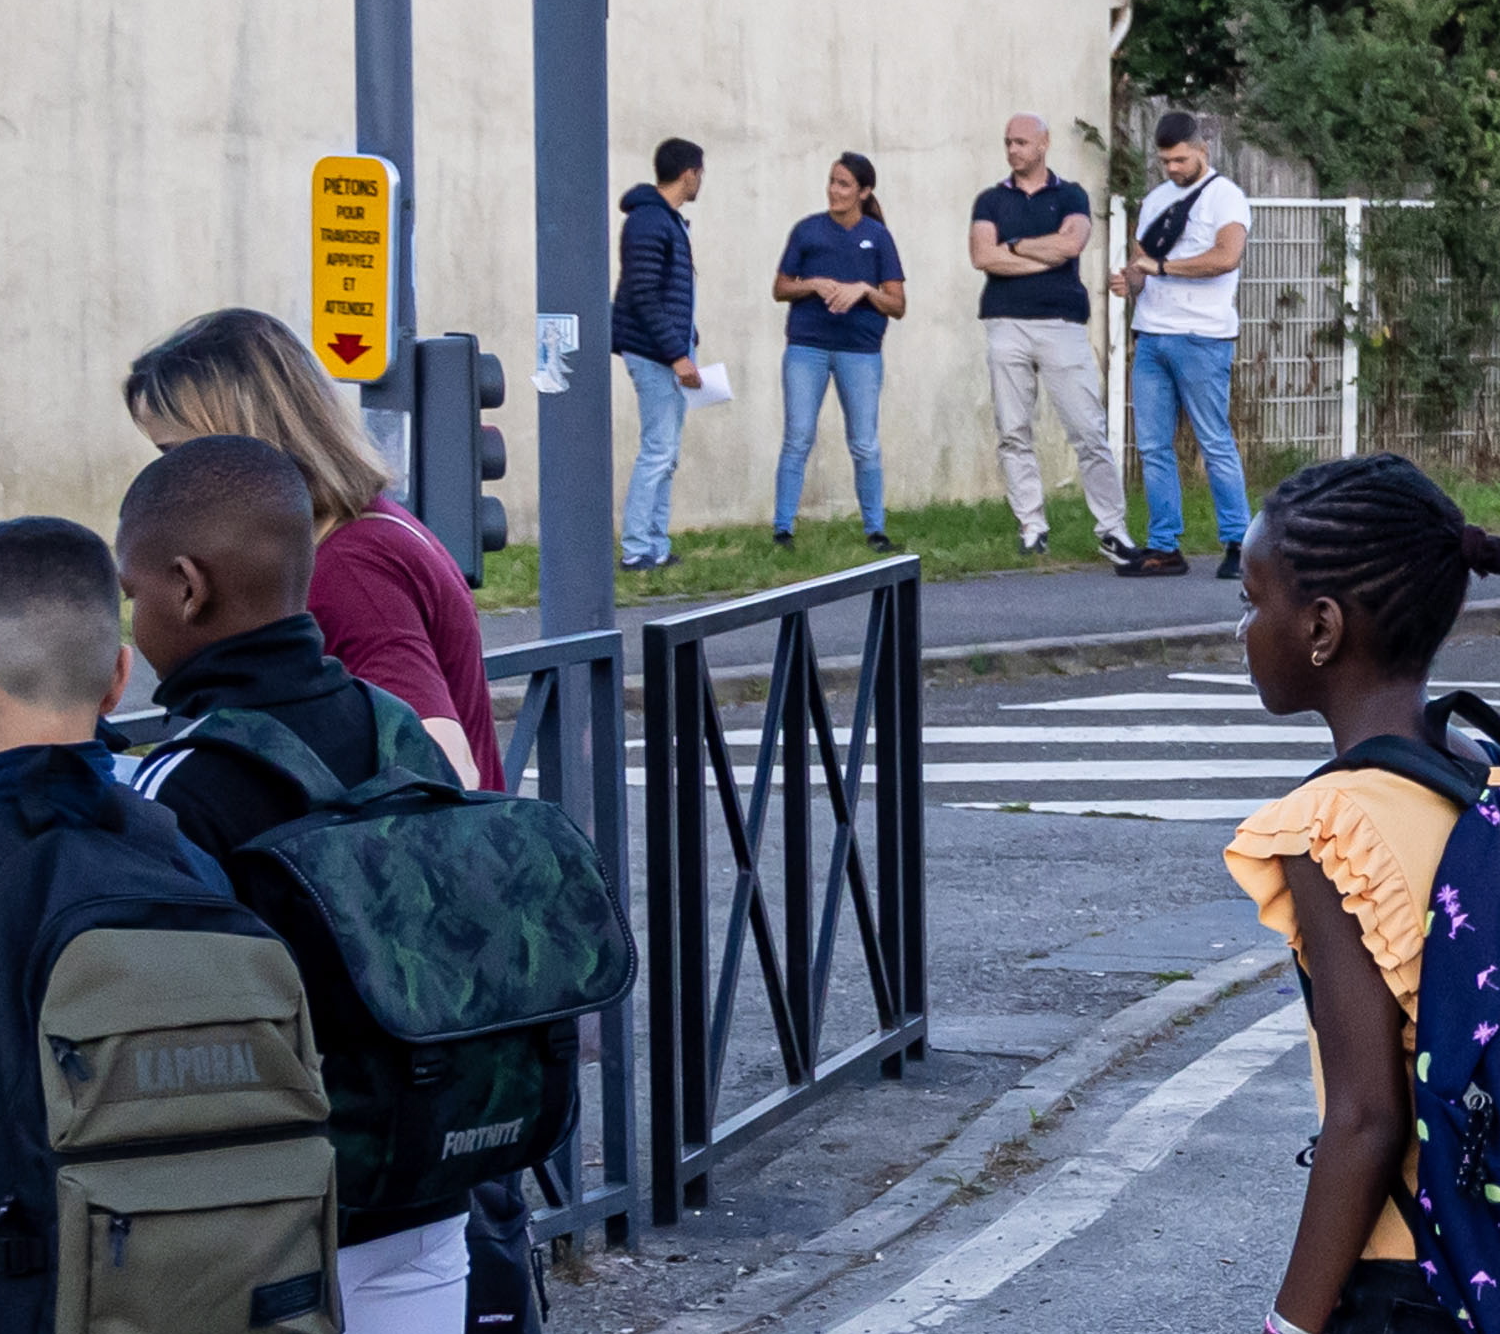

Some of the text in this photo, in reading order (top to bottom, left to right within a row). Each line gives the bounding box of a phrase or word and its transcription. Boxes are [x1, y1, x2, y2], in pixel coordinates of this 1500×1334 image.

[323, 175, 378, 197] PIÉTONS
[336, 205, 365, 220] POUR
[320, 228, 380, 245] TRAVERSER
[326, 252, 374, 269] APPUYEZ
[343, 277, 356, 291] ET
[325, 300, 374, 317] ATTENDEZ
[441, 1117, 524, 1161] FORTNITE
